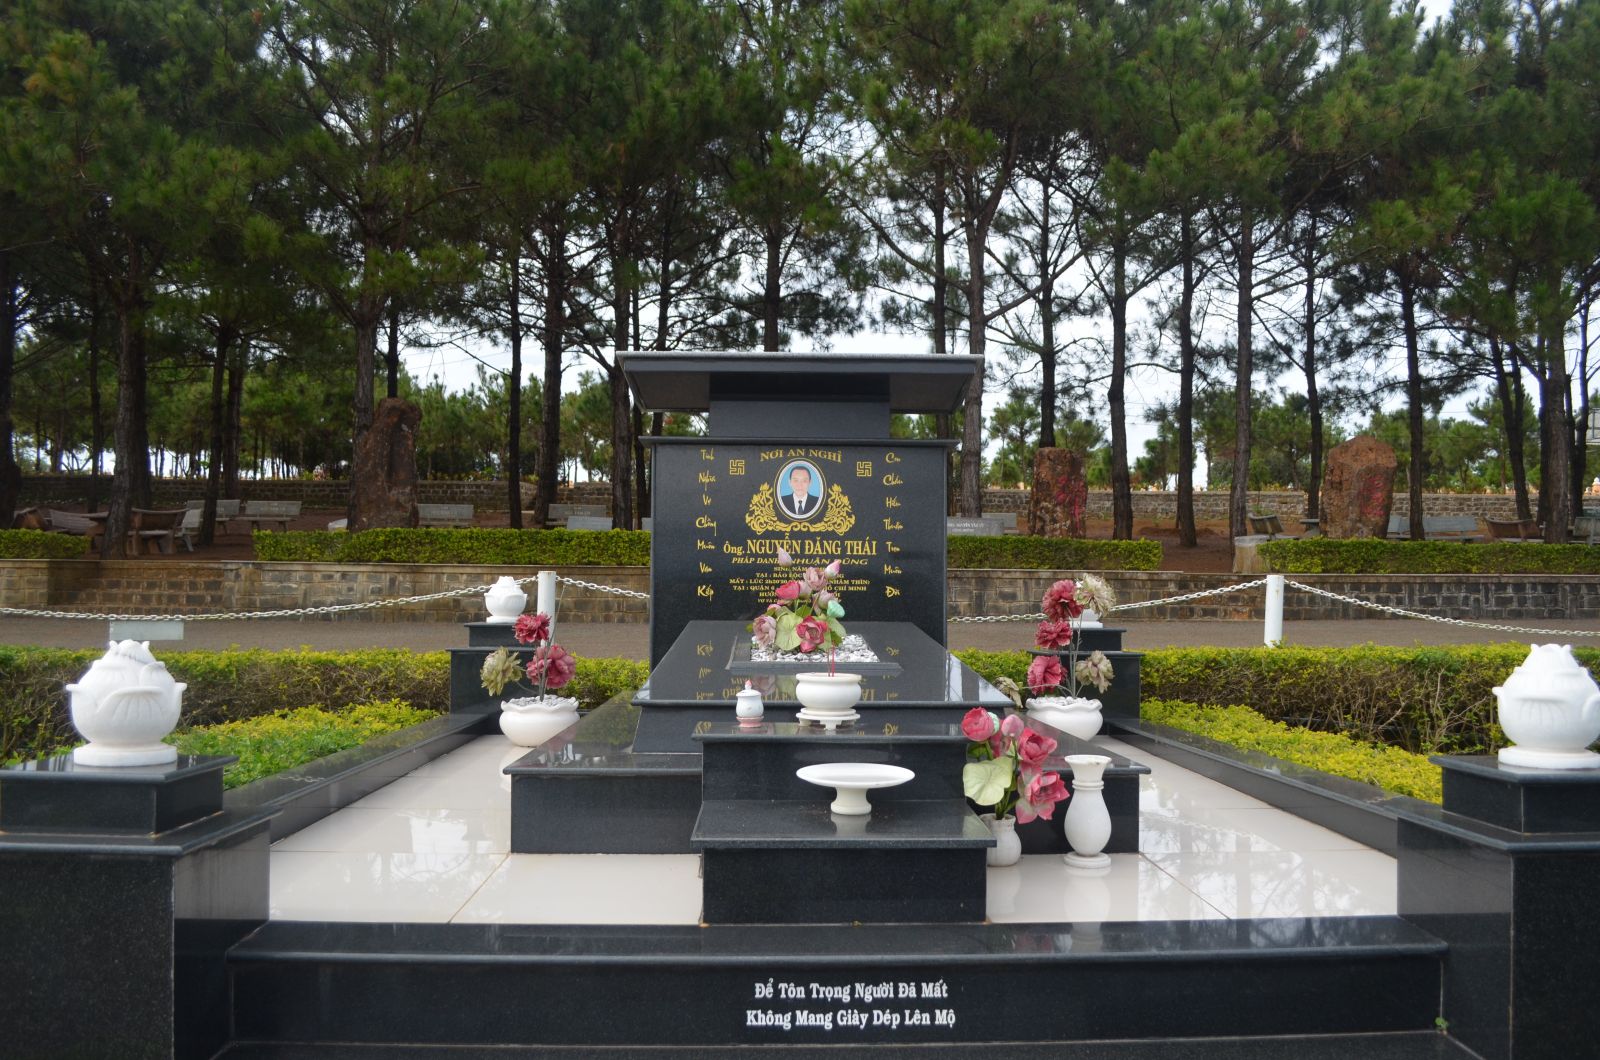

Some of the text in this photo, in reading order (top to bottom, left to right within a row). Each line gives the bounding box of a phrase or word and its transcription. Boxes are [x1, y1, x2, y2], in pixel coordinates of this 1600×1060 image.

[787, 448, 805, 457] AN
[746, 532, 801, 554] NGUYỄN
[844, 537, 878, 556] THÁI
[755, 977, 948, 1002] Để Tôn Trọng Người Đã Mất
[746, 1008, 956, 1030] Không Mang Giày Dép Lên Mộ
